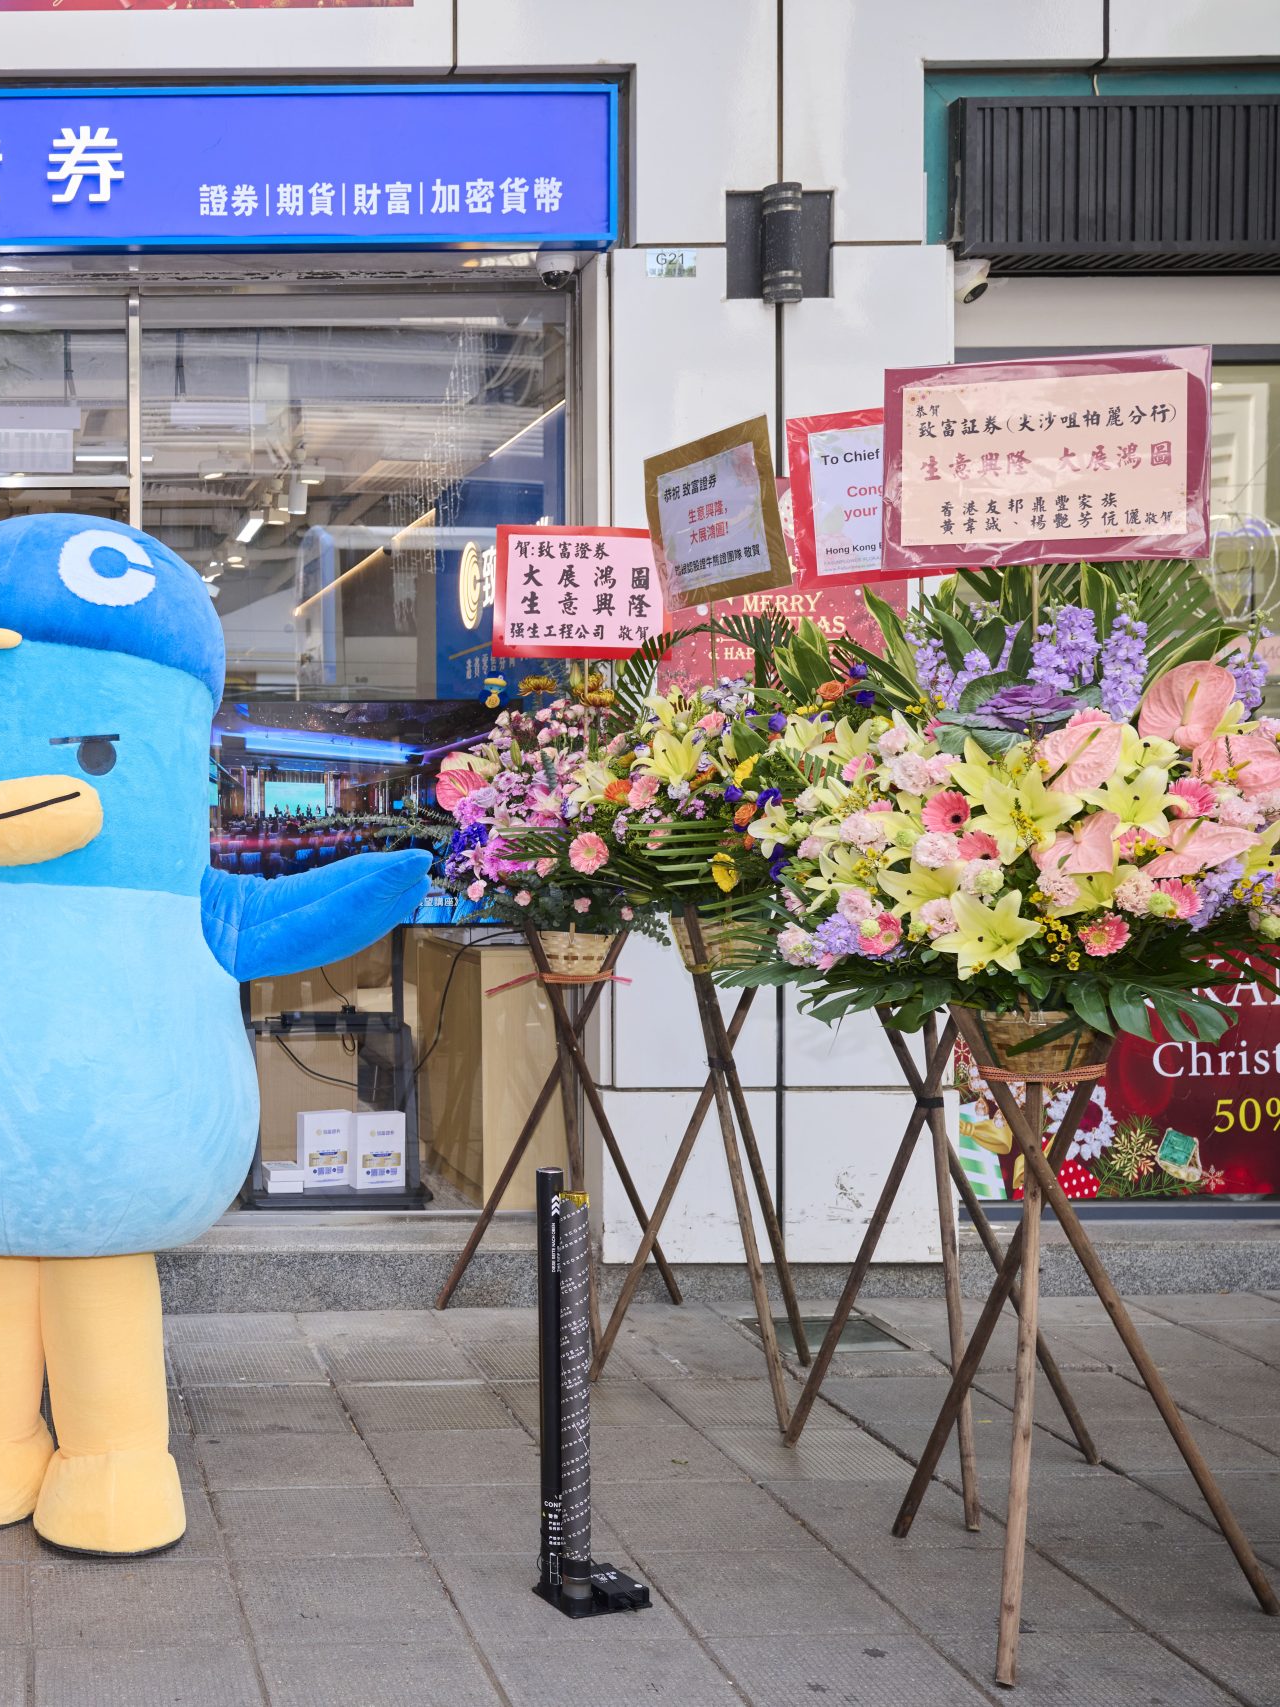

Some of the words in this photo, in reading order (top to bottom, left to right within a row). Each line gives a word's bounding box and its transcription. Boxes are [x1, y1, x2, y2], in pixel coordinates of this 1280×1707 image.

[199, 184, 258, 217] 證券
[276, 182, 336, 217] 期貨
[353, 181, 412, 216] 財富
[431, 176, 563, 215] 加密貨幣
[656, 253, 684, 265] G21
[915, 404, 941, 418] 恭賀
[821, 455, 839, 466] To
[843, 449, 880, 463] Chief
[920, 449, 1032, 482] 生意興隆
[1057, 440, 1173, 473] 大展鴻圖
[664, 486, 680, 503] 恭祝
[682, 474, 717, 497] 致富證券
[844, 506, 878, 521] your
[825, 546, 850, 555] Hong
[852, 543, 877, 552] Kong
[523, 564, 650, 590] 大展鴻圖
[521, 591, 651, 618] 生意興隆
[742, 591, 824, 613] MERRY
[724, 646, 755, 660] HAP
[420, 897, 458, 907] 望講座》
